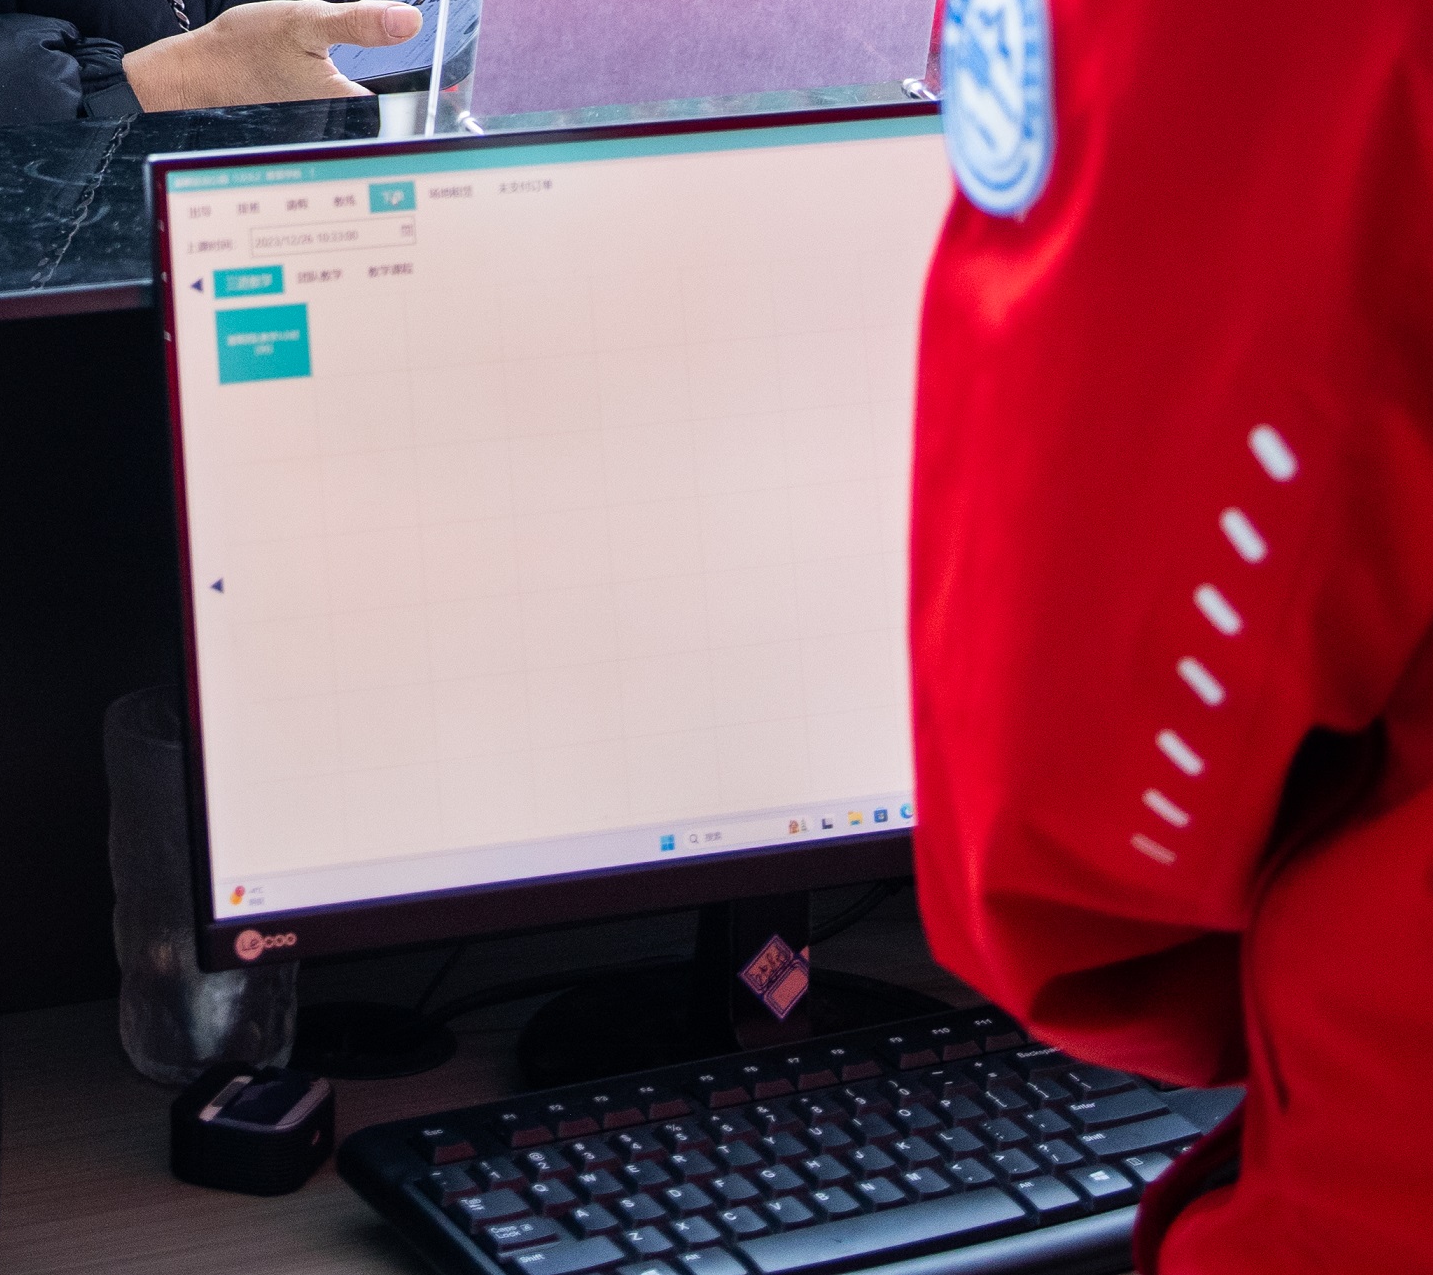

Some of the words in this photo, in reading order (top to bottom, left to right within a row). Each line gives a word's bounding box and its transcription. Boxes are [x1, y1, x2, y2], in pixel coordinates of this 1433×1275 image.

[1017, 1046, 1064, 1060] Backspac
[1070, 1101, 1098, 1112] Enter
[518, 1253, 545, 1264] Shift
[1081, 1132, 1107, 1143] Shift
